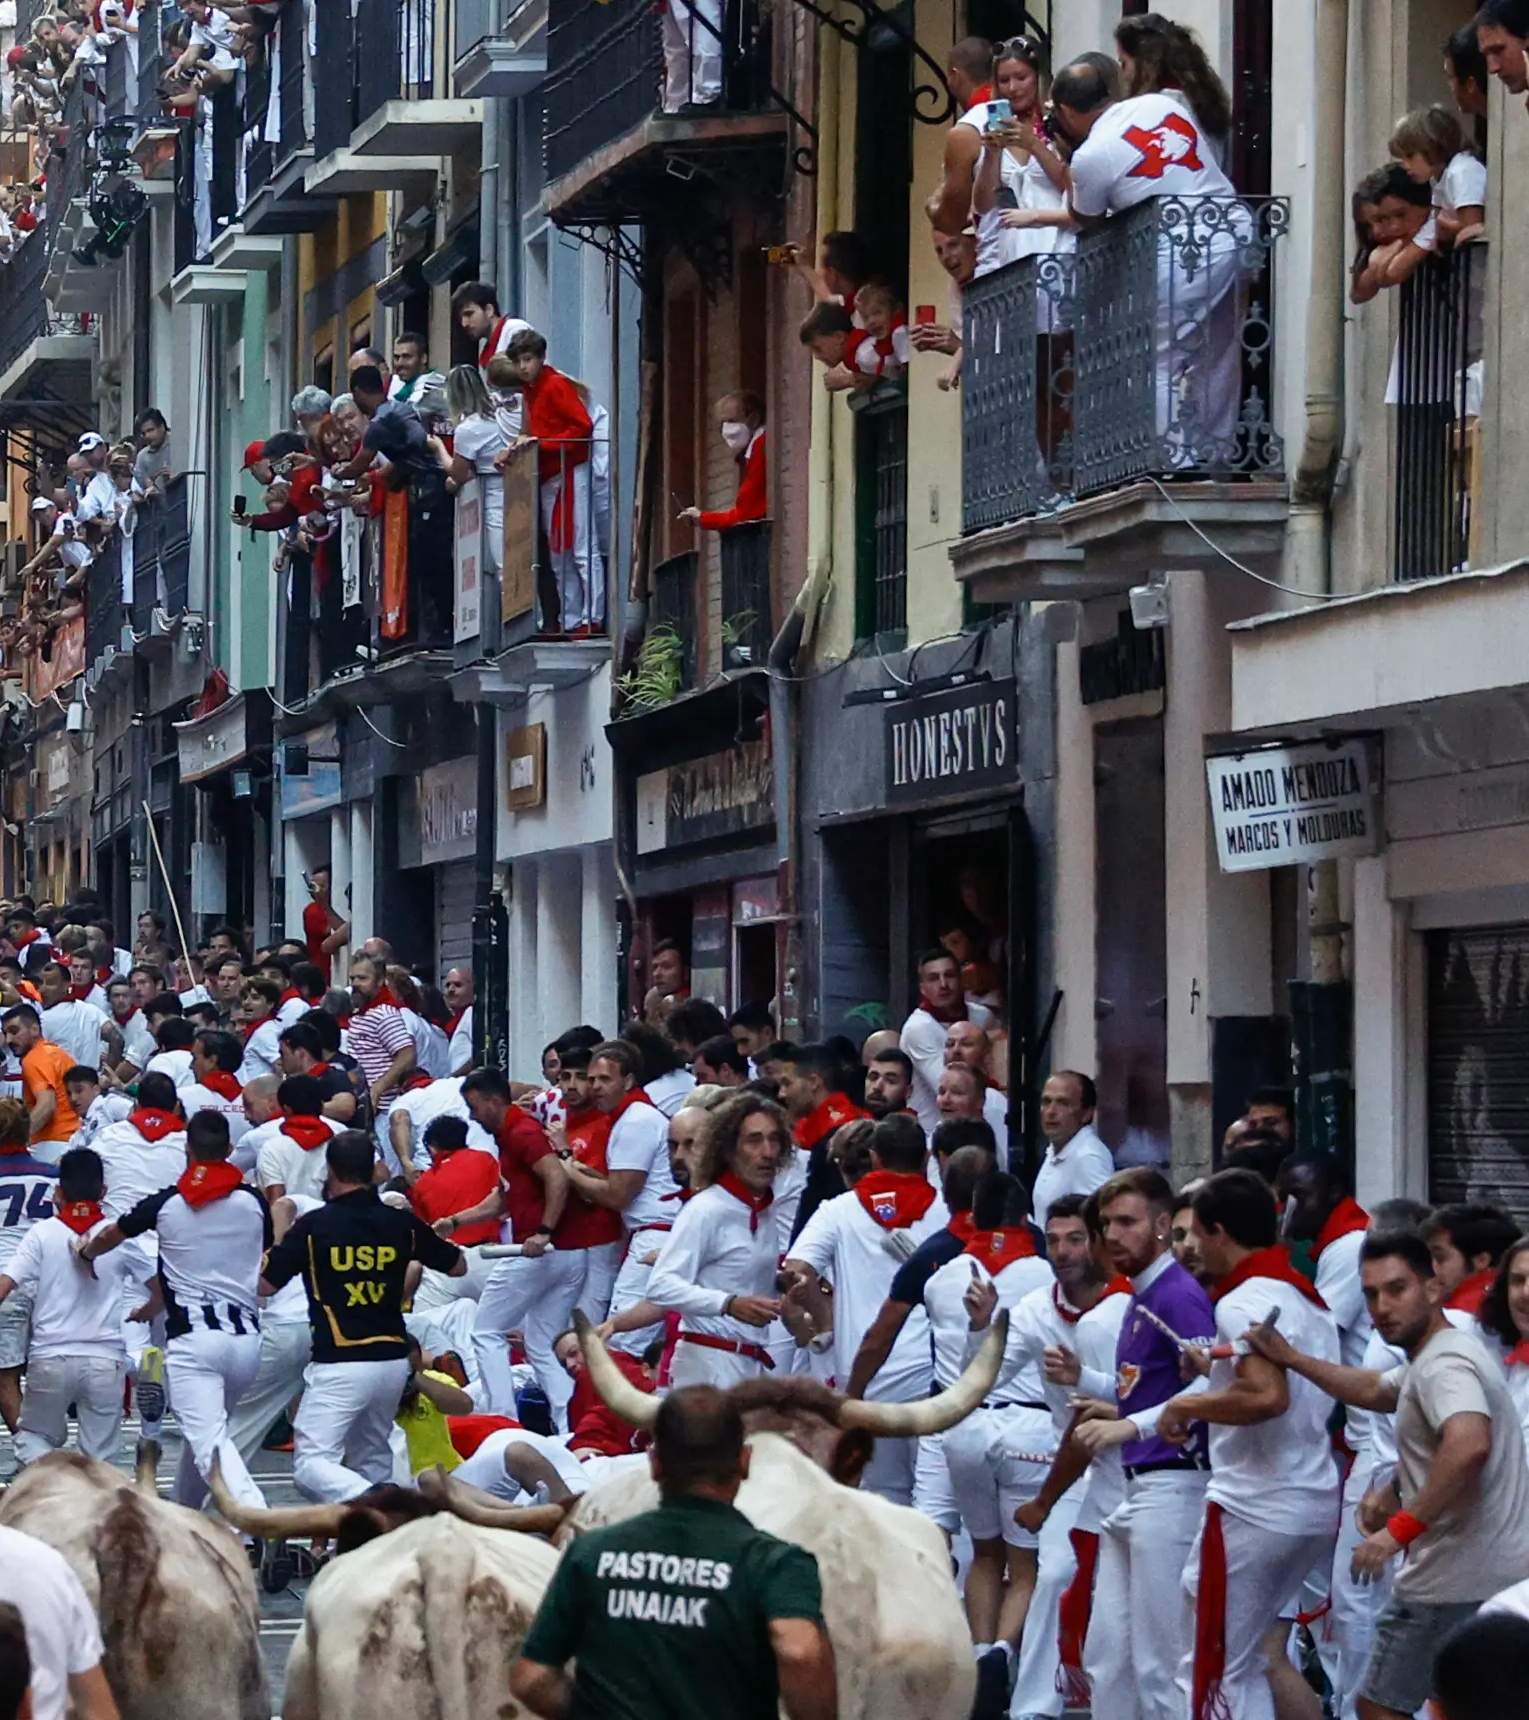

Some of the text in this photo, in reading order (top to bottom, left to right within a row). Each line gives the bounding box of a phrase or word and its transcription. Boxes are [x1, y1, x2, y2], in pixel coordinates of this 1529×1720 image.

[892, 699, 1006, 785] HONESTVS
[1221, 756, 1361, 813] AMADO MENDOZA
[1225, 808, 1366, 855] MARCOS Y MOLDURAS
[330, 1245, 397, 1272] USP
[343, 1281, 387, 1307] XV
[596, 1551, 733, 1590] PASTORES
[607, 1588, 709, 1628] UNAIAK
